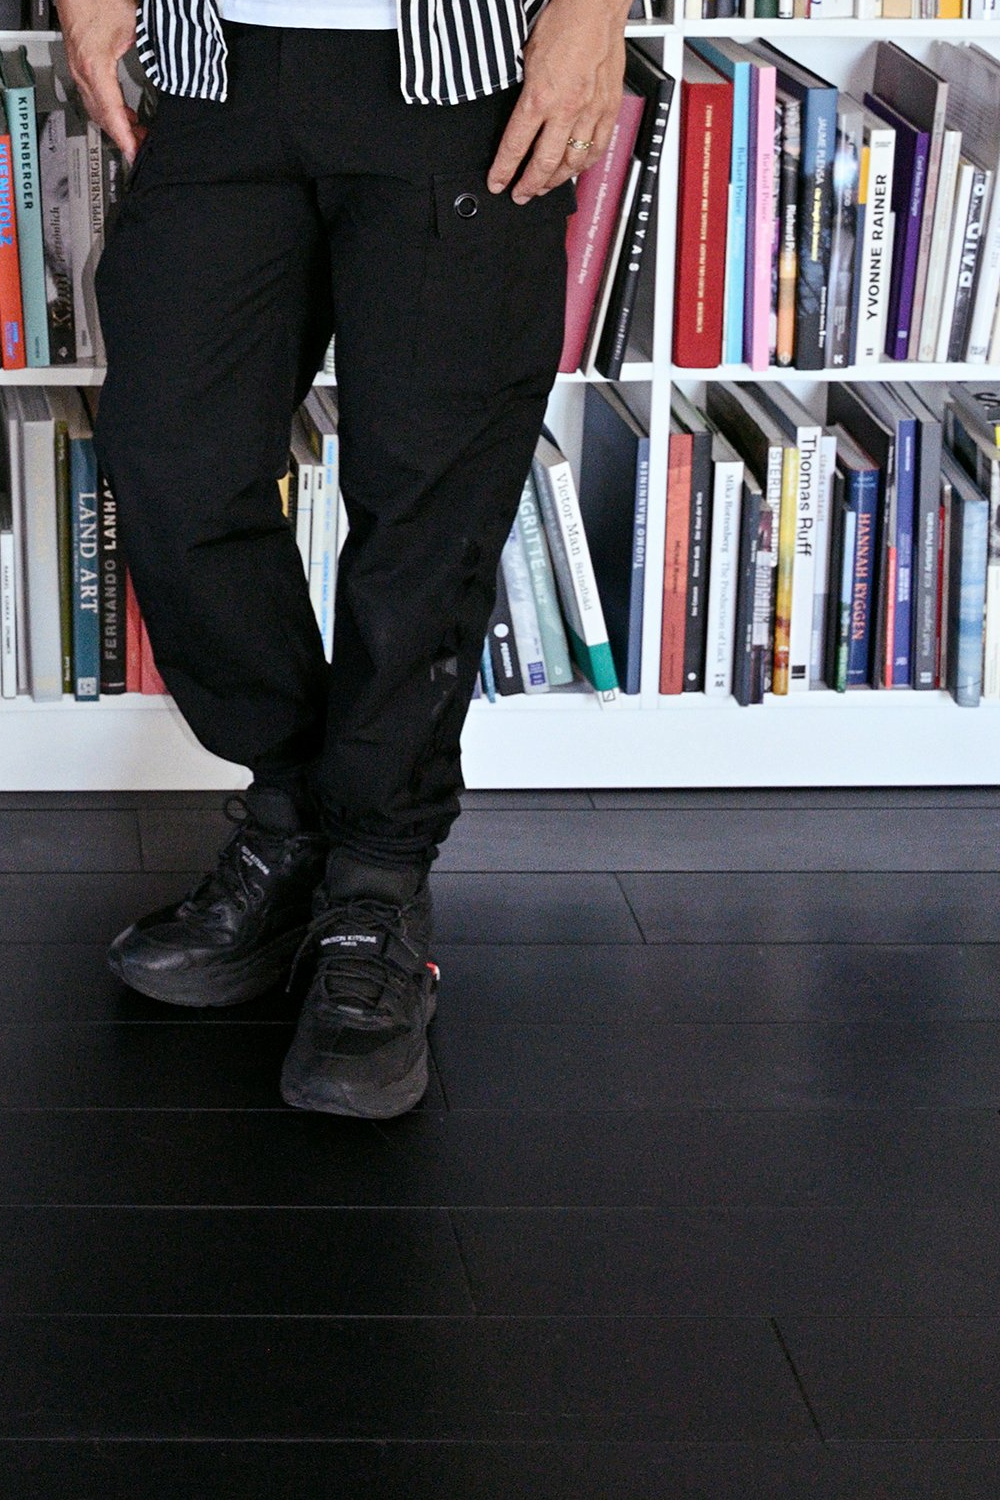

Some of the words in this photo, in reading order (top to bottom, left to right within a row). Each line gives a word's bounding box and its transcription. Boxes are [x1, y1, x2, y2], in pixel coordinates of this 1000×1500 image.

[18, 96, 34, 210] KIPPENBERGER
[646, 102, 669, 172] FERIT
[89, 146, 102, 235] KIPPENBERGER
[786, 204, 796, 240] Richard
[868, 175, 887, 241] RAINER
[628, 193, 652, 272] KUYAS
[866, 247, 882, 320] YVONNE
[556, 473, 575, 520] Victor
[635, 461, 649, 525] MANNINEN
[724, 474, 735, 498] Mika
[798, 435, 817, 511] Thomas
[78, 492, 98, 560] LAND
[565, 523, 582, 557] Man
[633, 528, 645, 570] TUOMO
[719, 500, 732, 553] Rottenberg
[797, 518, 813, 557] Ruff
[855, 513, 871, 578] HANNAH
[79, 568, 98, 614] ART
[103, 559, 118, 660] FERNANDO
[718, 579, 730, 626] Production
[852, 583, 869, 641] RYGGEN
